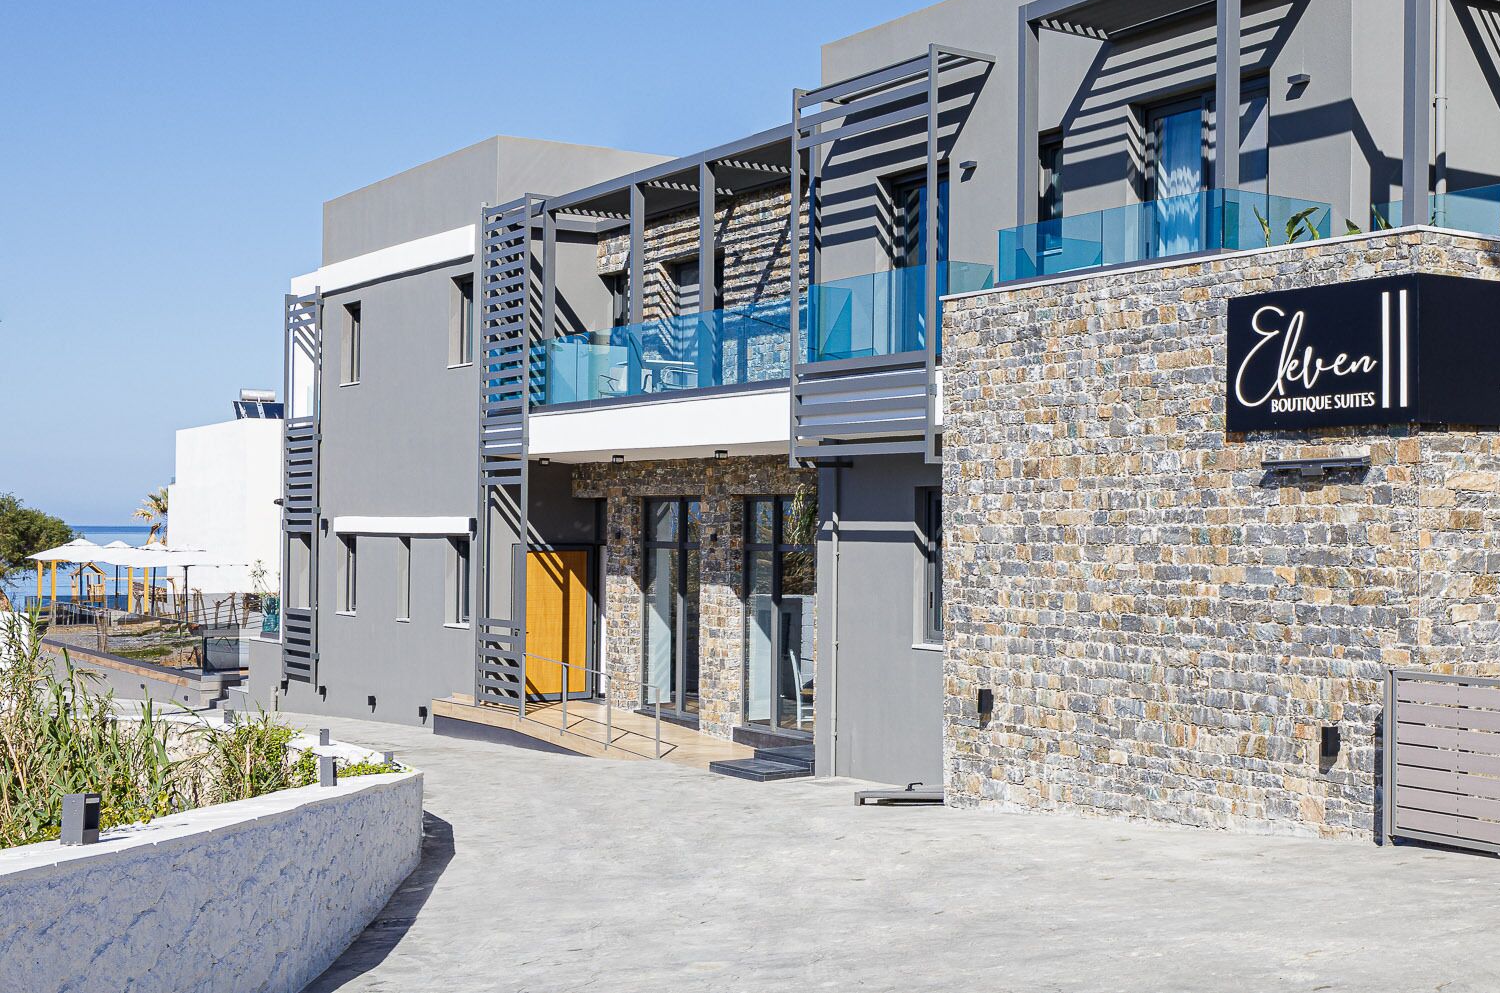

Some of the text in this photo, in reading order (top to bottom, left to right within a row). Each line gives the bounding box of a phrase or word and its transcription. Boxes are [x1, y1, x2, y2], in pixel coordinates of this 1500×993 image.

[1235, 305, 1377, 407] Eleven
[1271, 392, 1375, 413] BOUTIQUE SUITES
